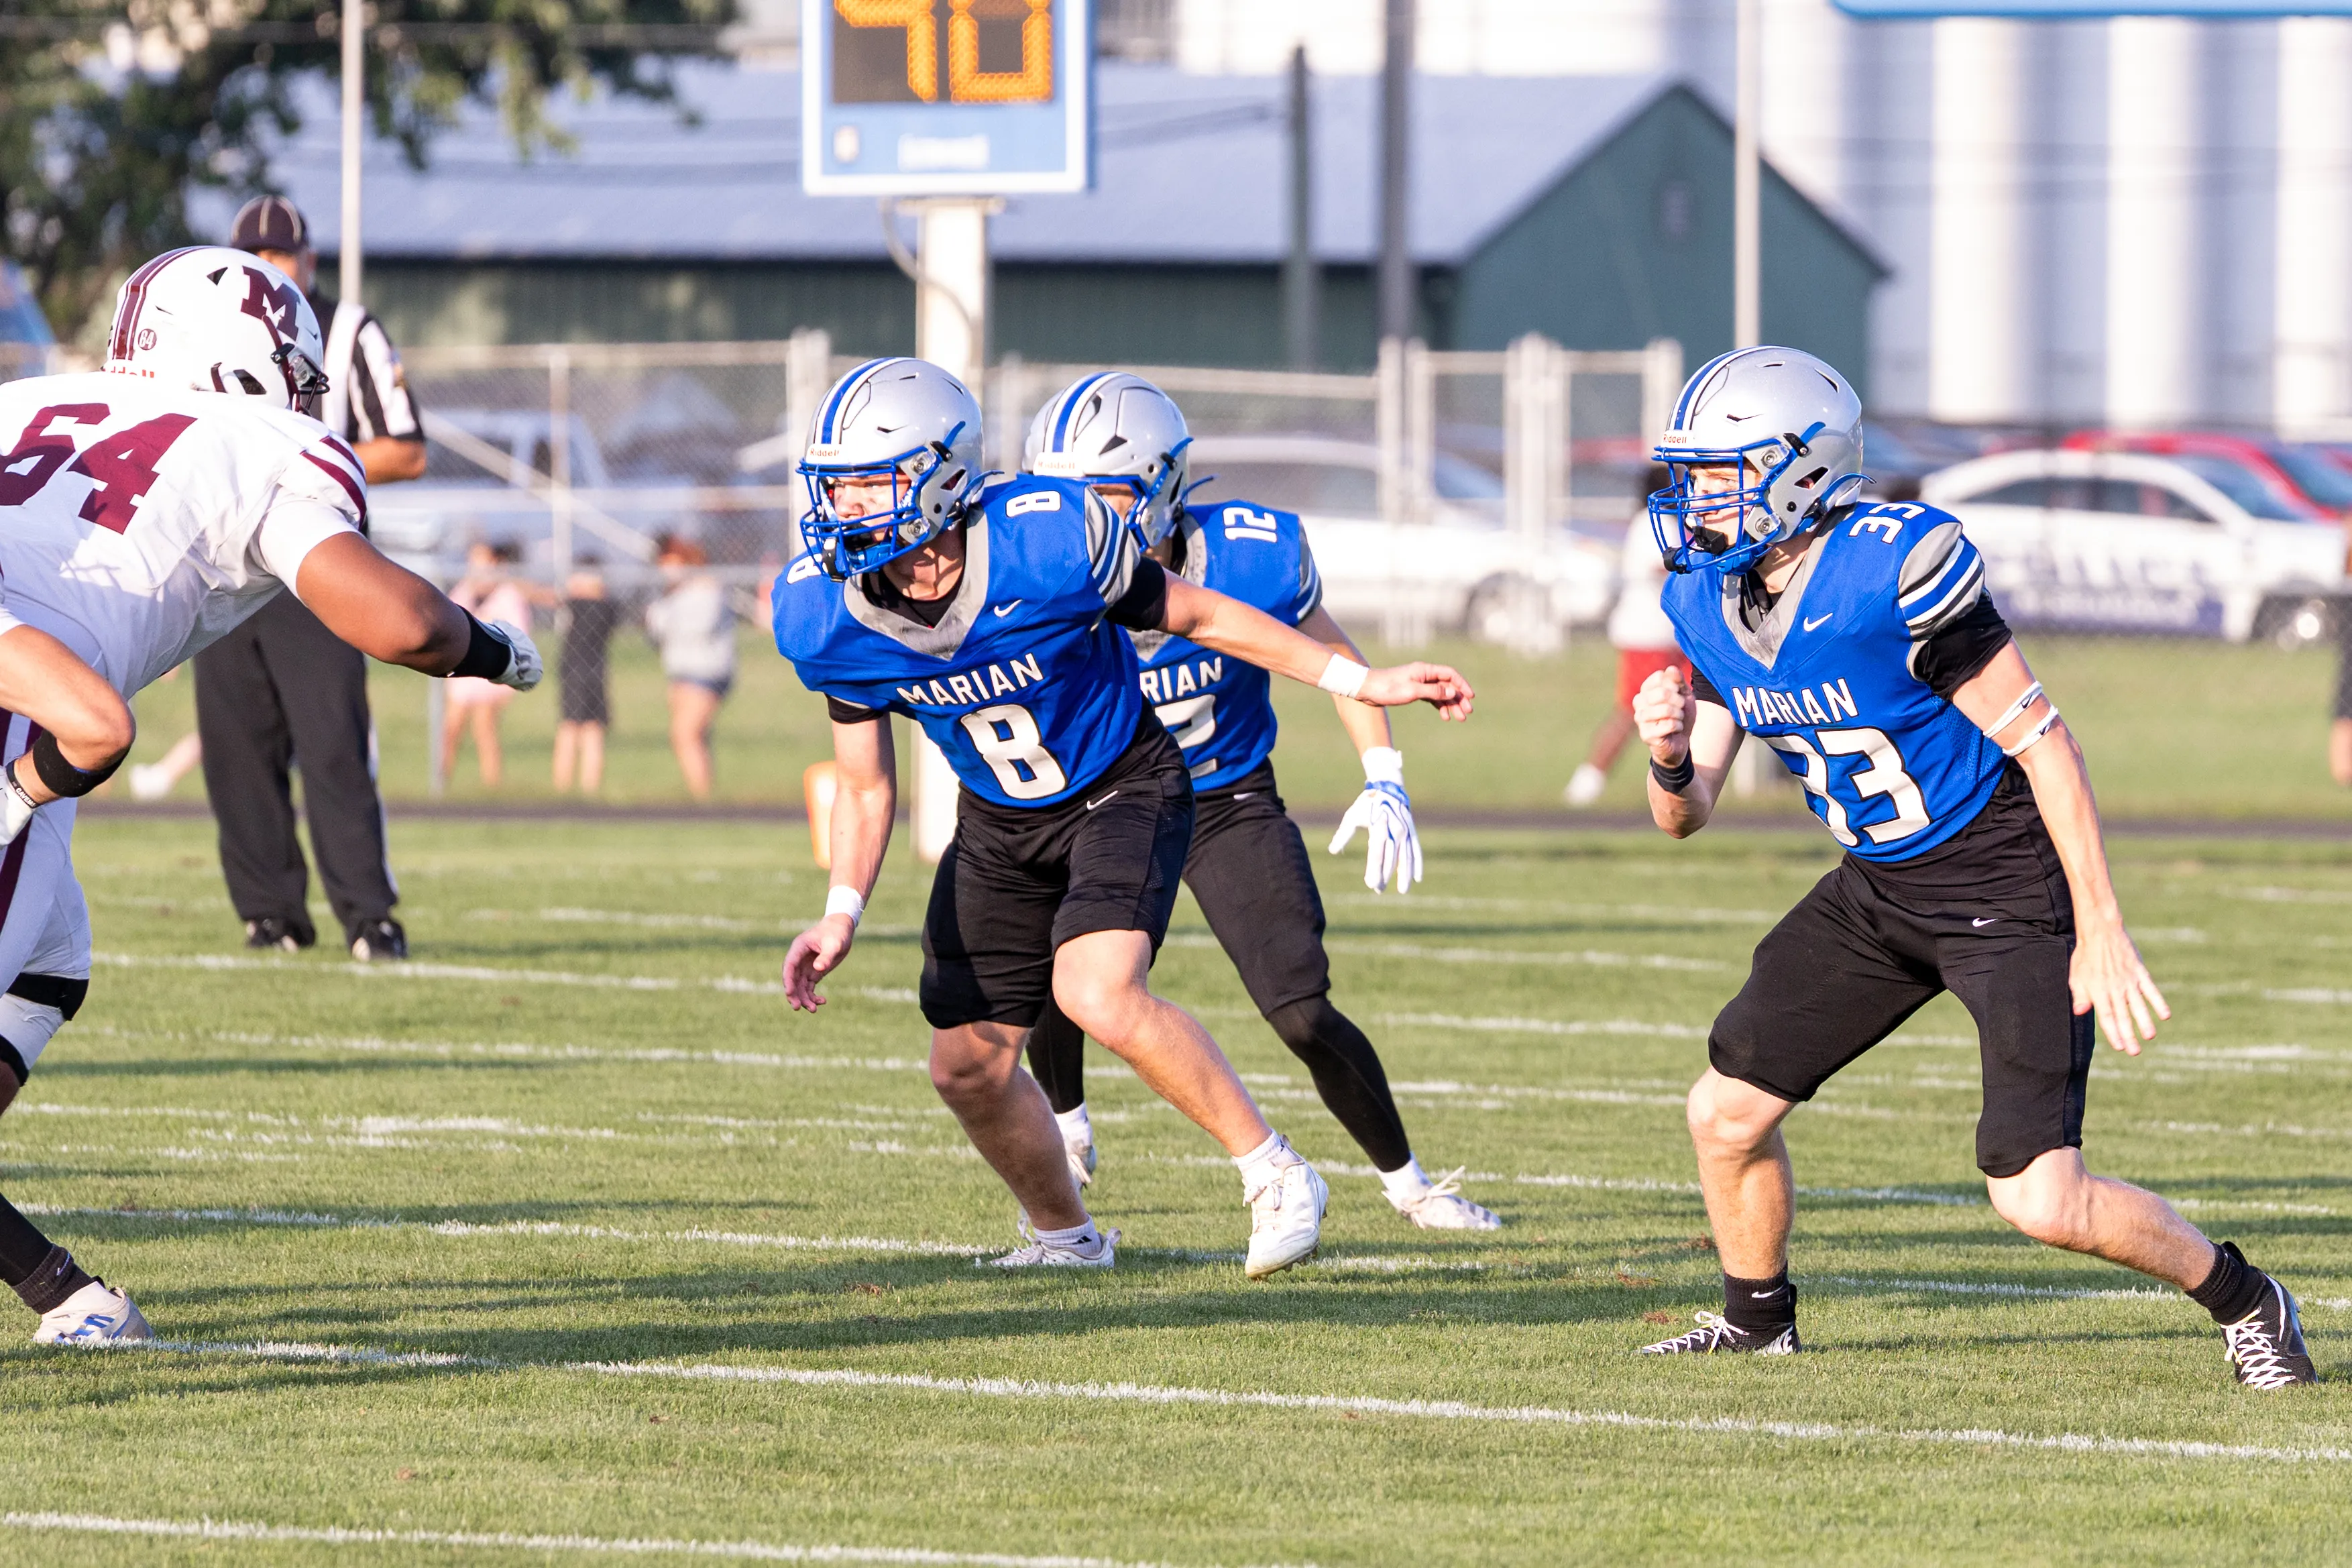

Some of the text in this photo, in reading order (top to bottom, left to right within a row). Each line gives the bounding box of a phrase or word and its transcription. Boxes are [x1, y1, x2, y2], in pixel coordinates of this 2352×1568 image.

[240, 265, 301, 342] M
[139, 329, 155, 349] 64
[0, 402, 199, 535] 64
[1006, 490, 1061, 518] 8
[1223, 506, 1278, 543] 12
[1848, 502, 1926, 545] 33
[896, 653, 1044, 706] MARIAN
[1139, 656, 1222, 703] RIAN
[1732, 677, 1859, 728] MARIAN
[960, 704, 1068, 799] 8
[1154, 693, 1218, 780] 2
[1752, 726, 1934, 847] 33
